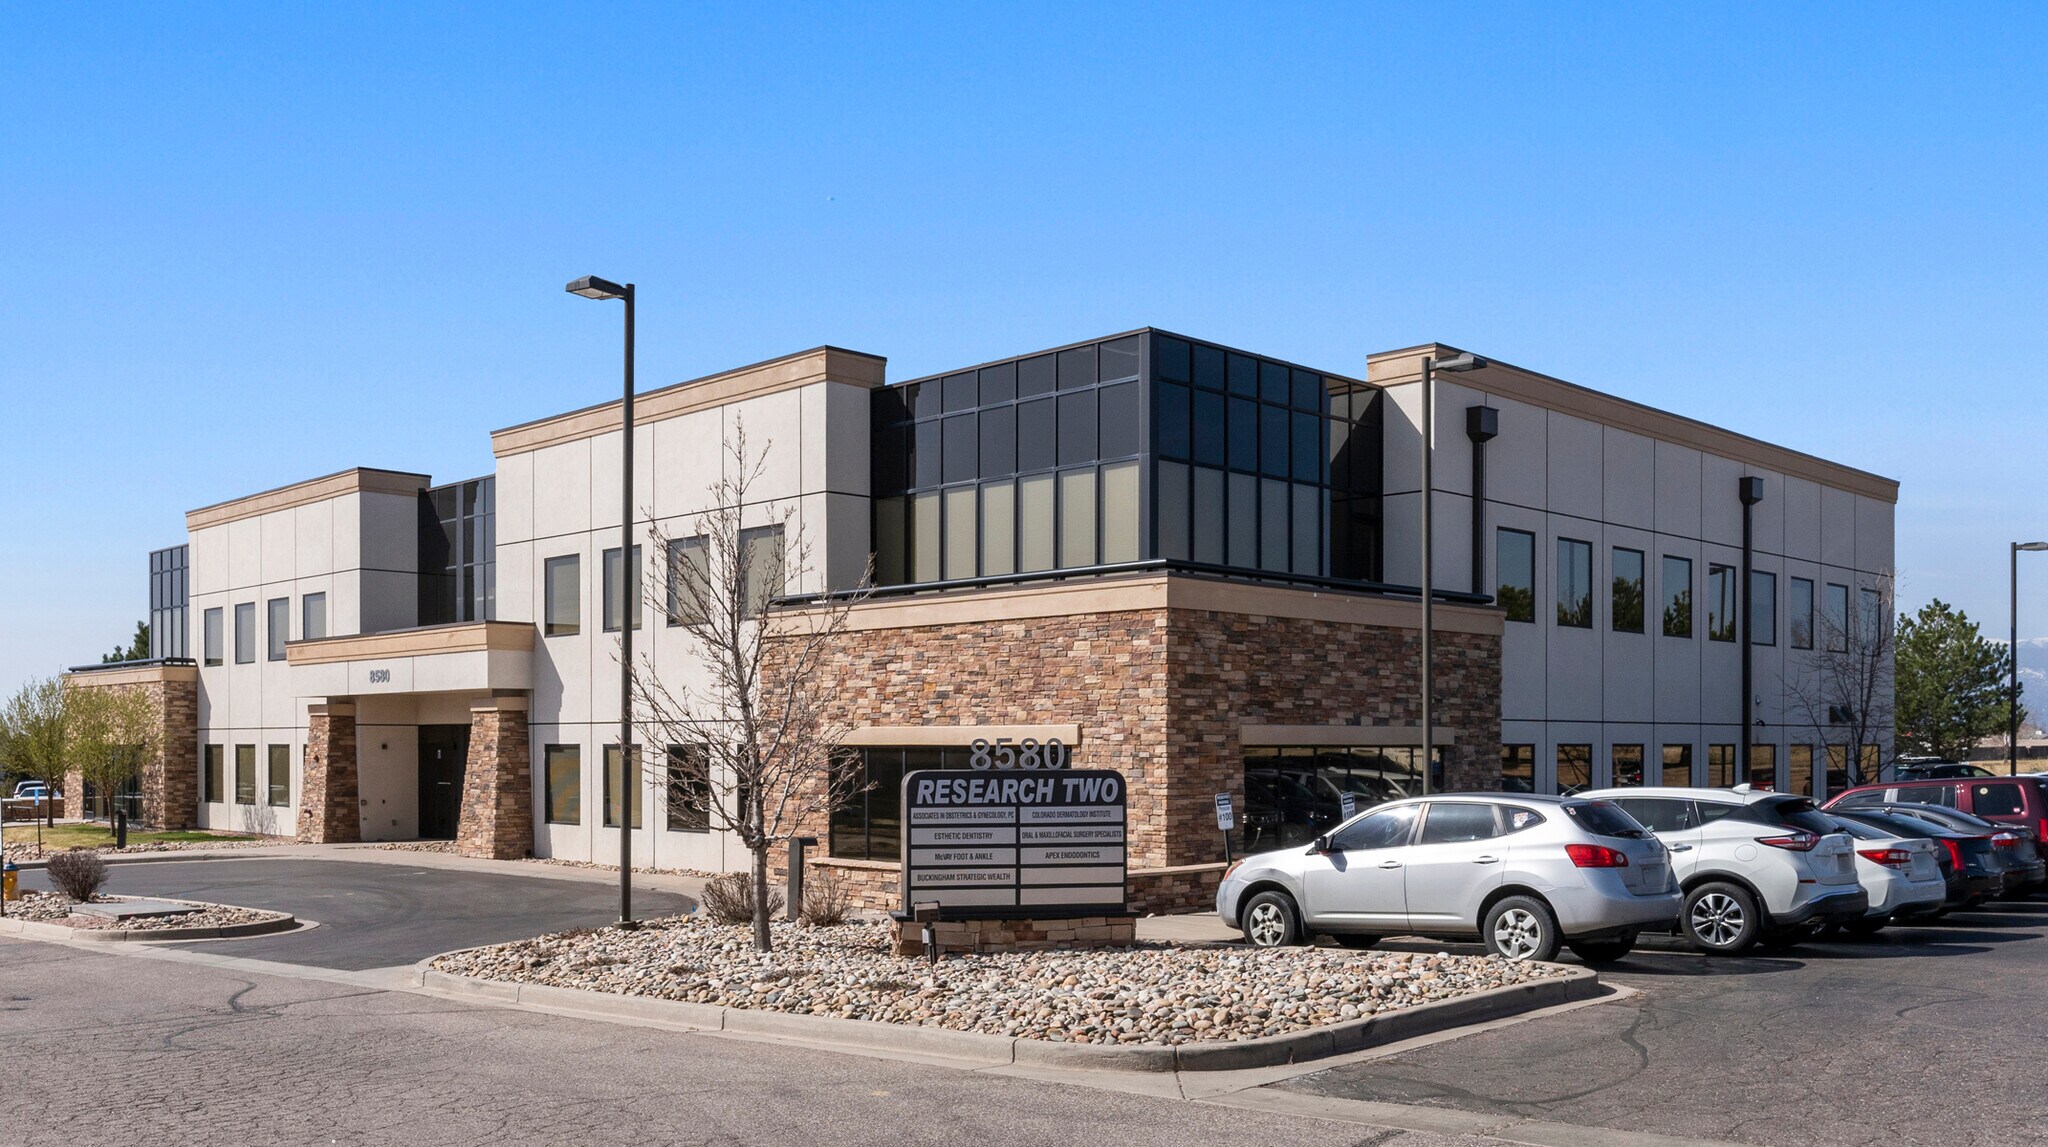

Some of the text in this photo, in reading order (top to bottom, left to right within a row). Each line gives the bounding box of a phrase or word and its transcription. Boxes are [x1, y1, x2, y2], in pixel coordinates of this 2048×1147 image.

[370, 669, 390, 683] 8580
[970, 737, 1065, 770] 8580
[916, 777, 1119, 804] RESEARCH TWO
[913, 812, 939, 820] ASSOCIATES
[940, 811, 945, 819] IN
[945, 811, 973, 820] OBSTETRICS
[973, 811, 977, 819] &
[1008, 811, 1014, 819] PC
[1032, 811, 1056, 819] COLORADO
[1089, 810, 1111, 818] INSTITUTE
[934, 832, 993, 840] ESTHETIC DENTISTRY
[1022, 831, 1034, 839] ORAL
[1094, 830, 1122, 838] SPECIALISTS
[935, 853, 953, 861] McVAY
[974, 852, 993, 860] ANKLE
[1061, 851, 1100, 859] ENDODONTICS
[956, 873, 987, 881] STRATEGIC
